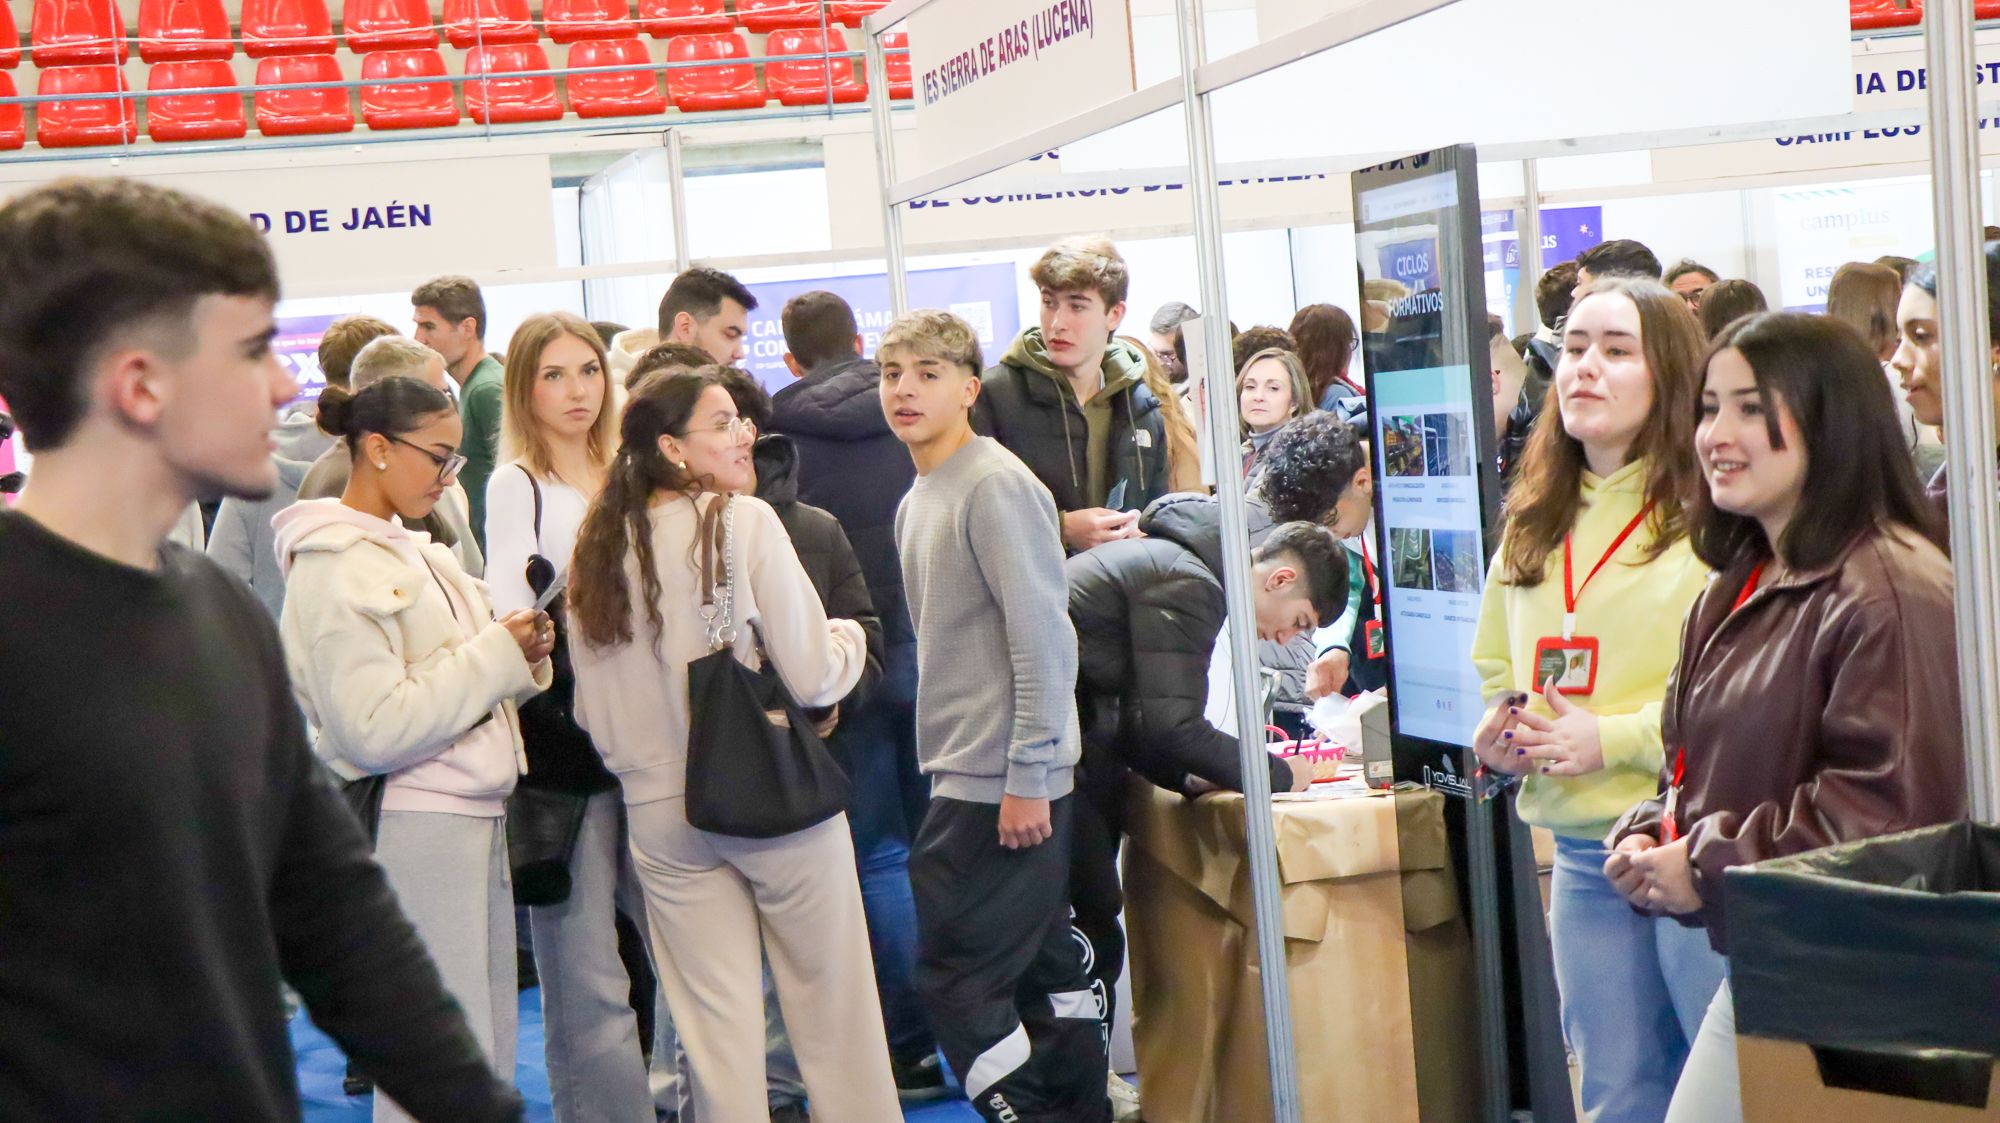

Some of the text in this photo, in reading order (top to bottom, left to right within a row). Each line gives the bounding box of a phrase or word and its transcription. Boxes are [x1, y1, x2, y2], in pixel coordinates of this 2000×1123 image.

[923, 0, 1094, 106] IES SIERRA DE ARAS (LUCENA)
[285, 209, 330, 234] DE
[342, 200, 432, 232] JAÉN
[1800, 207, 1891, 232] camplus
[1396, 252, 1429, 277] CICLOS
[1804, 266, 1837, 280] RES
